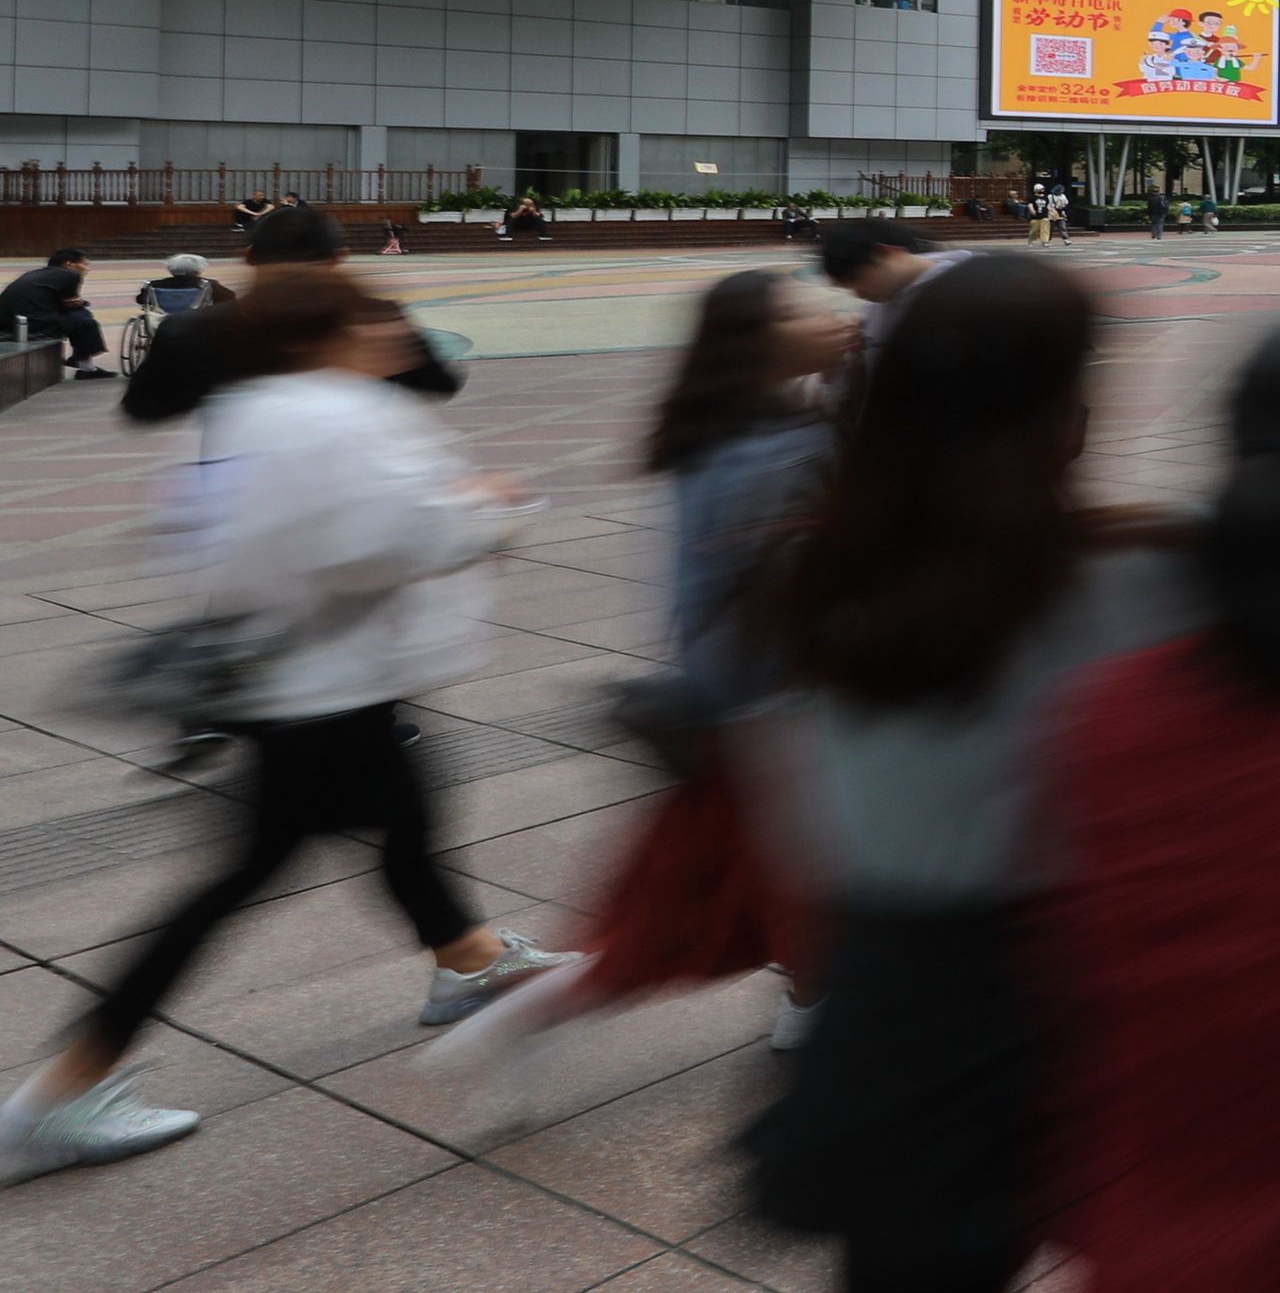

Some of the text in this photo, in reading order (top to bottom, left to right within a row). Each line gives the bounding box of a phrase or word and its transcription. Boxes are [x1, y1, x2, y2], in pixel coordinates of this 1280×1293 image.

[1025, 8, 1110, 31] 劳动节
[1060, 83, 1097, 96] 324
